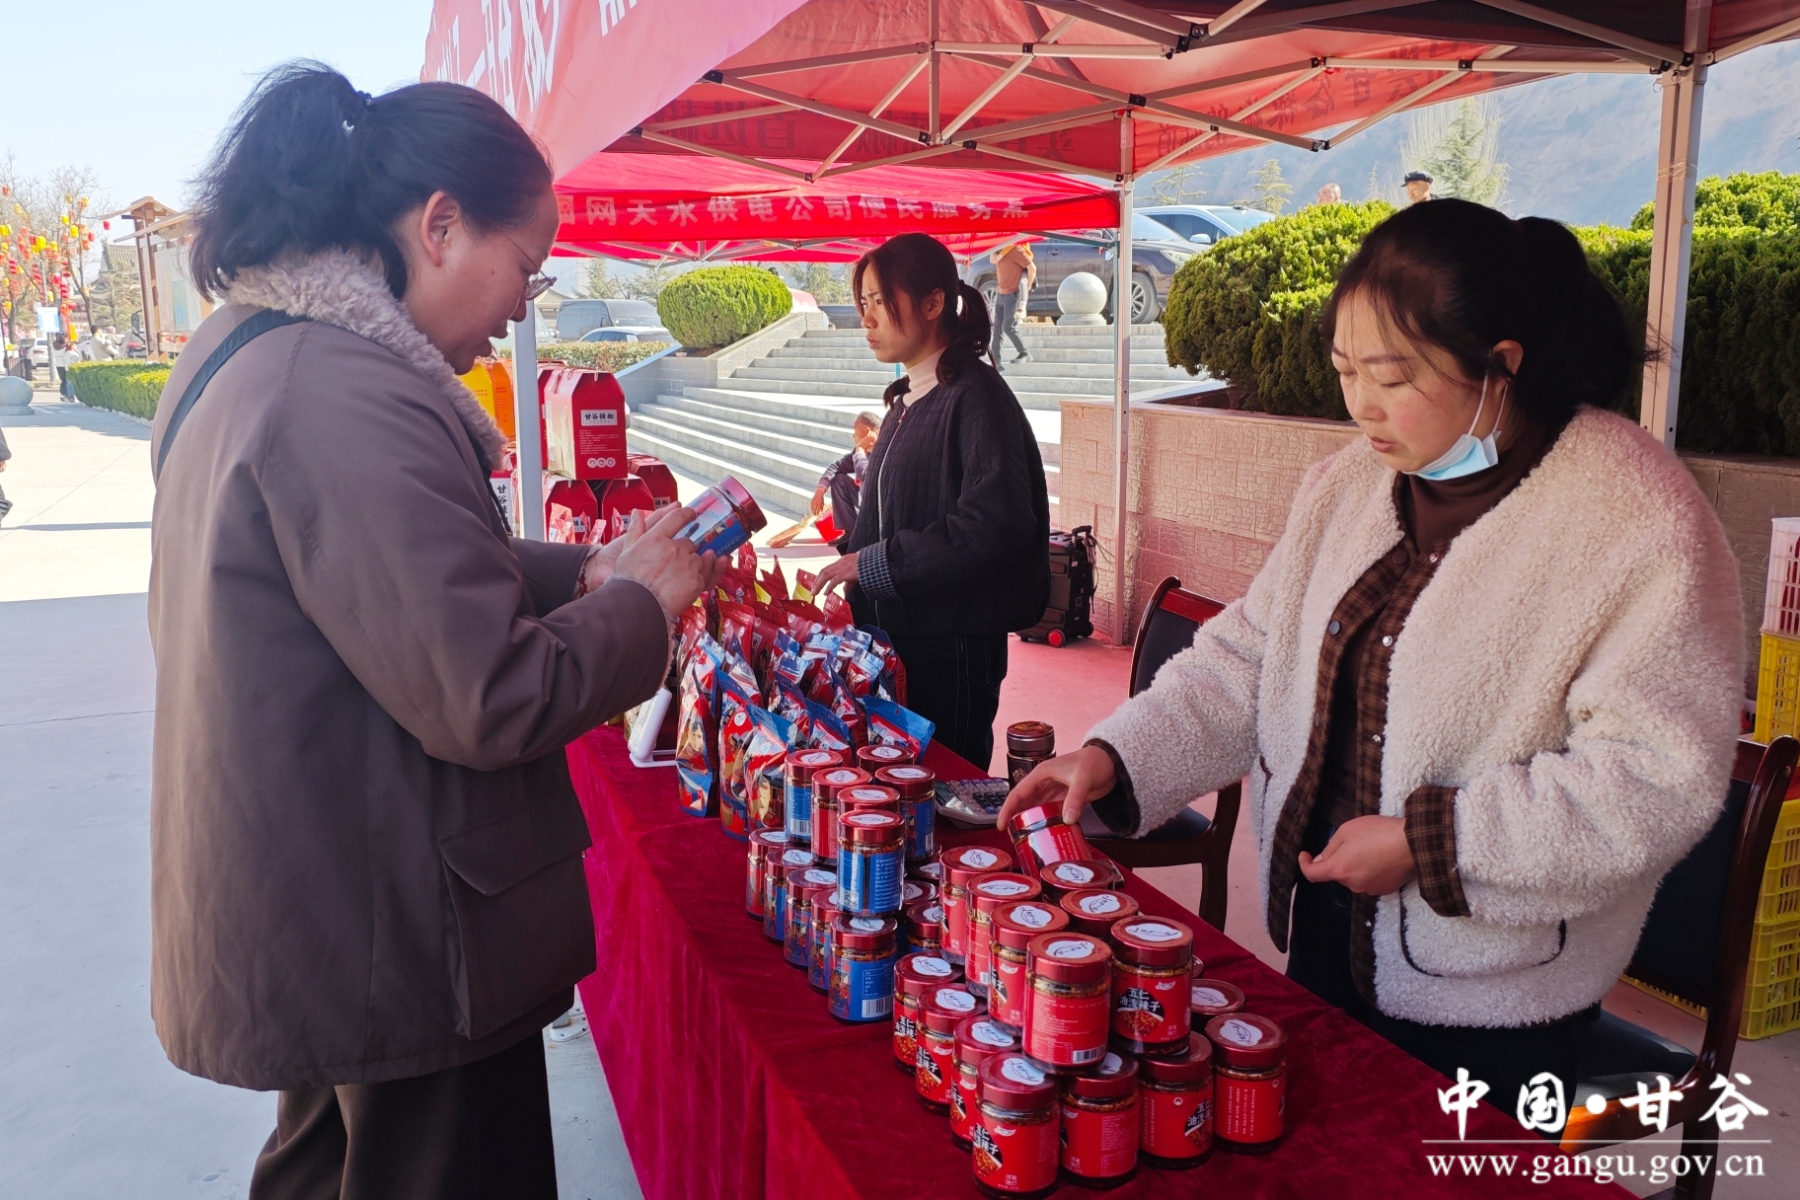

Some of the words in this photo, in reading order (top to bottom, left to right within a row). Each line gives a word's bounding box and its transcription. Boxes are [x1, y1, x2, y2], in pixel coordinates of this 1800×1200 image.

[584, 412, 614, 420] 甘谷辣椒
[1129, 987, 1149, 1000] 五仁
